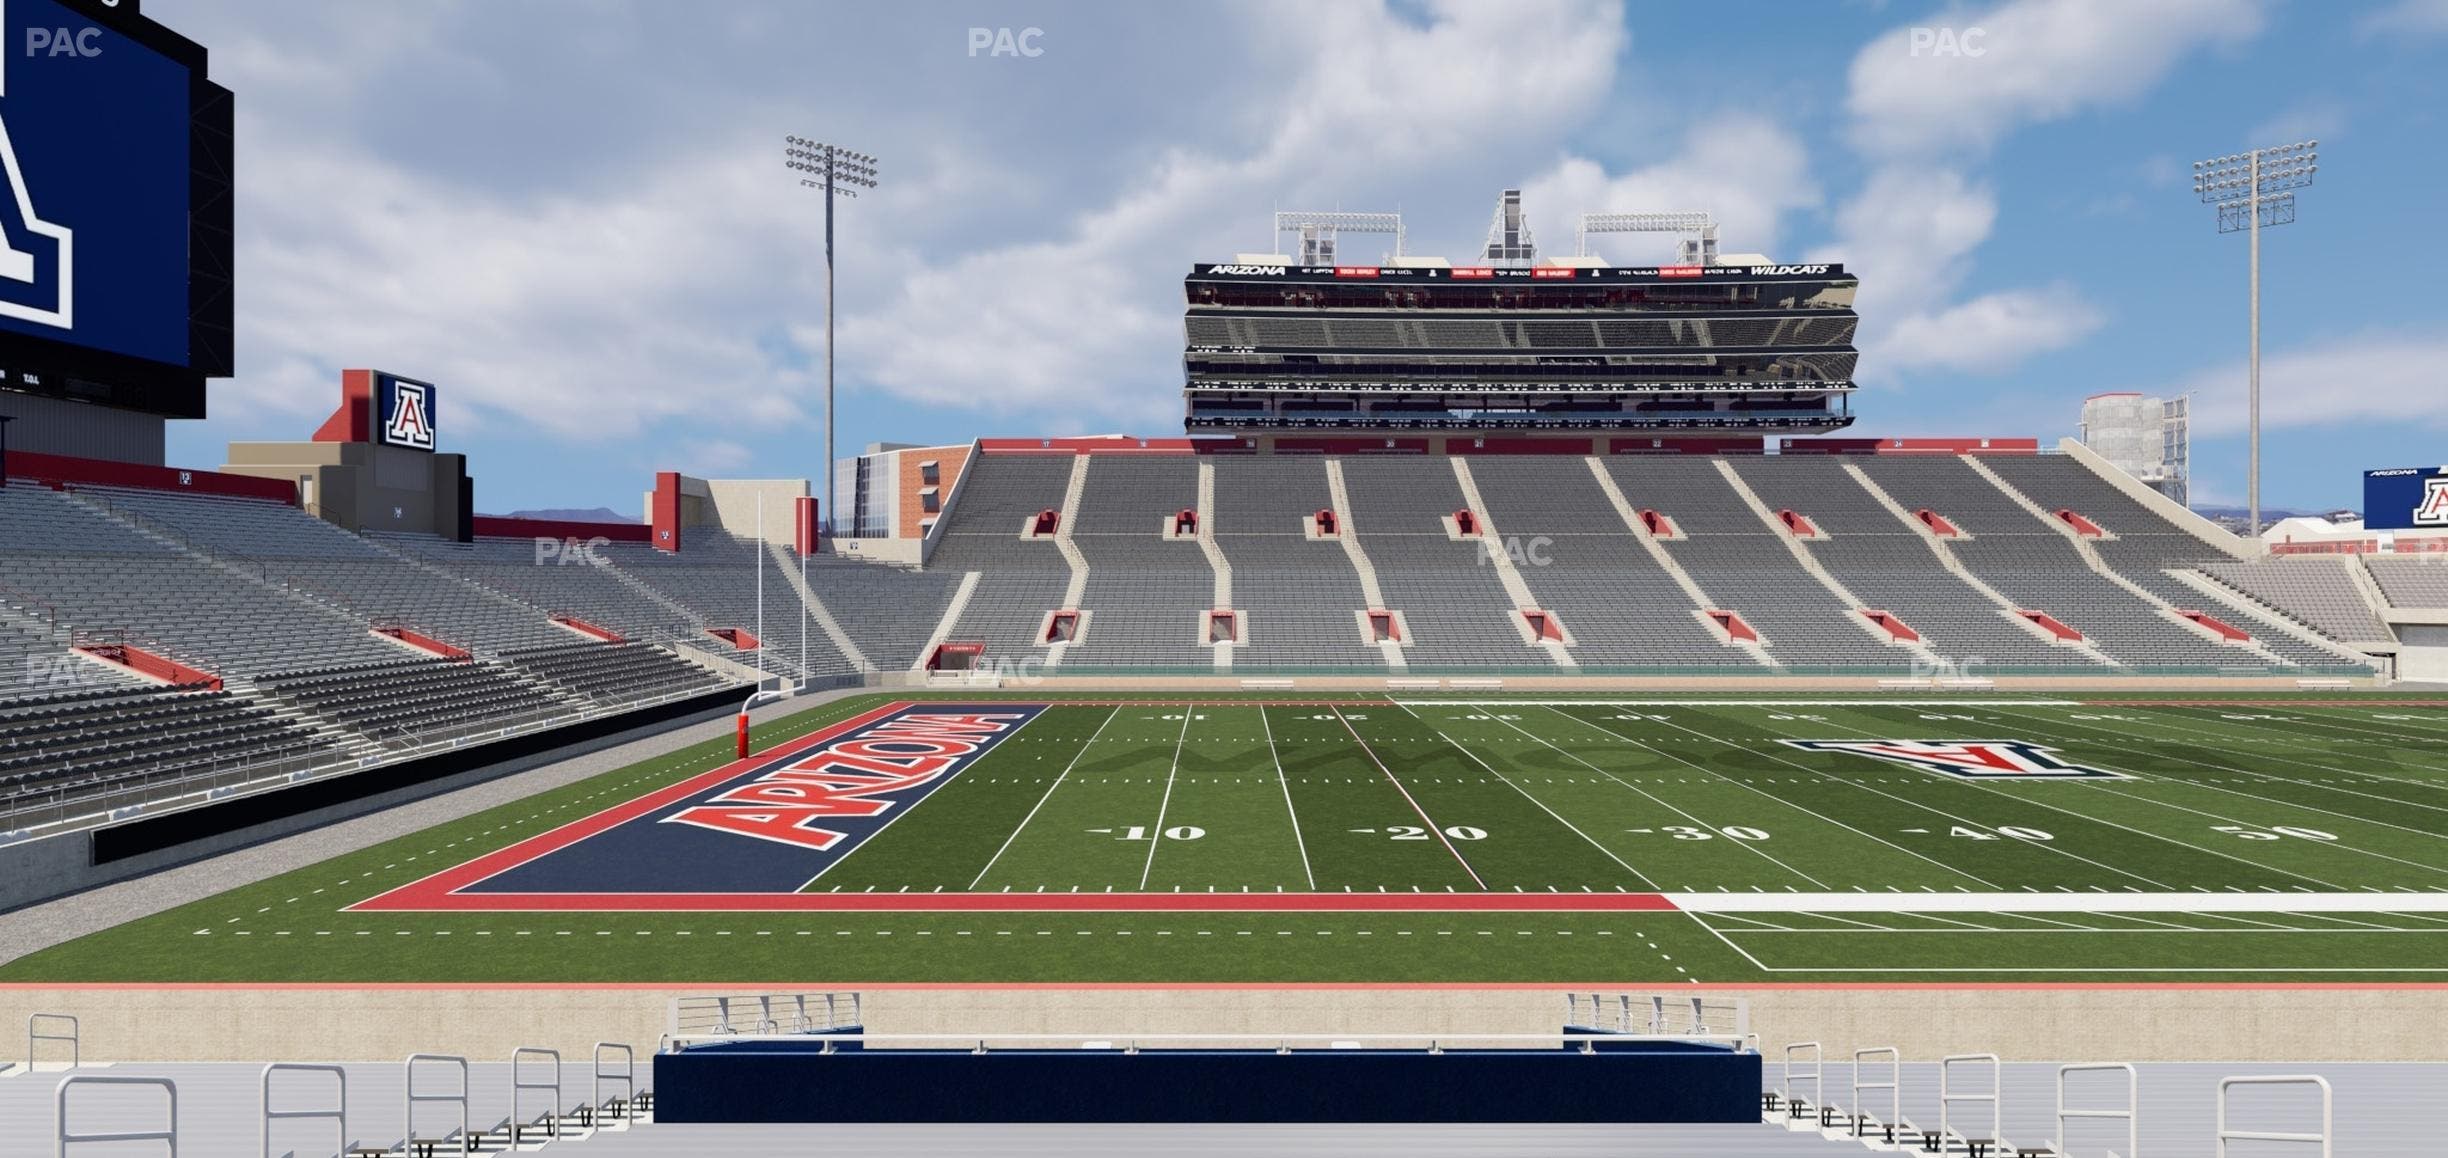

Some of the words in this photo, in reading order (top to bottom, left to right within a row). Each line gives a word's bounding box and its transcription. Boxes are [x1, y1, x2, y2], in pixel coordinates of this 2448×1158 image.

[1208, 265, 1286, 275] ARIZONA
[1751, 265, 1829, 276] WILDCATS
[386, 381, 434, 450] A
[656, 714, 1024, 851] ARIZONA
[1115, 826, 1206, 840] 10
[1386, 826, 1488, 840] 20
[1661, 826, 1770, 840] 30
[1950, 826, 2054, 840] 40
[2209, 826, 2339, 840] 50
